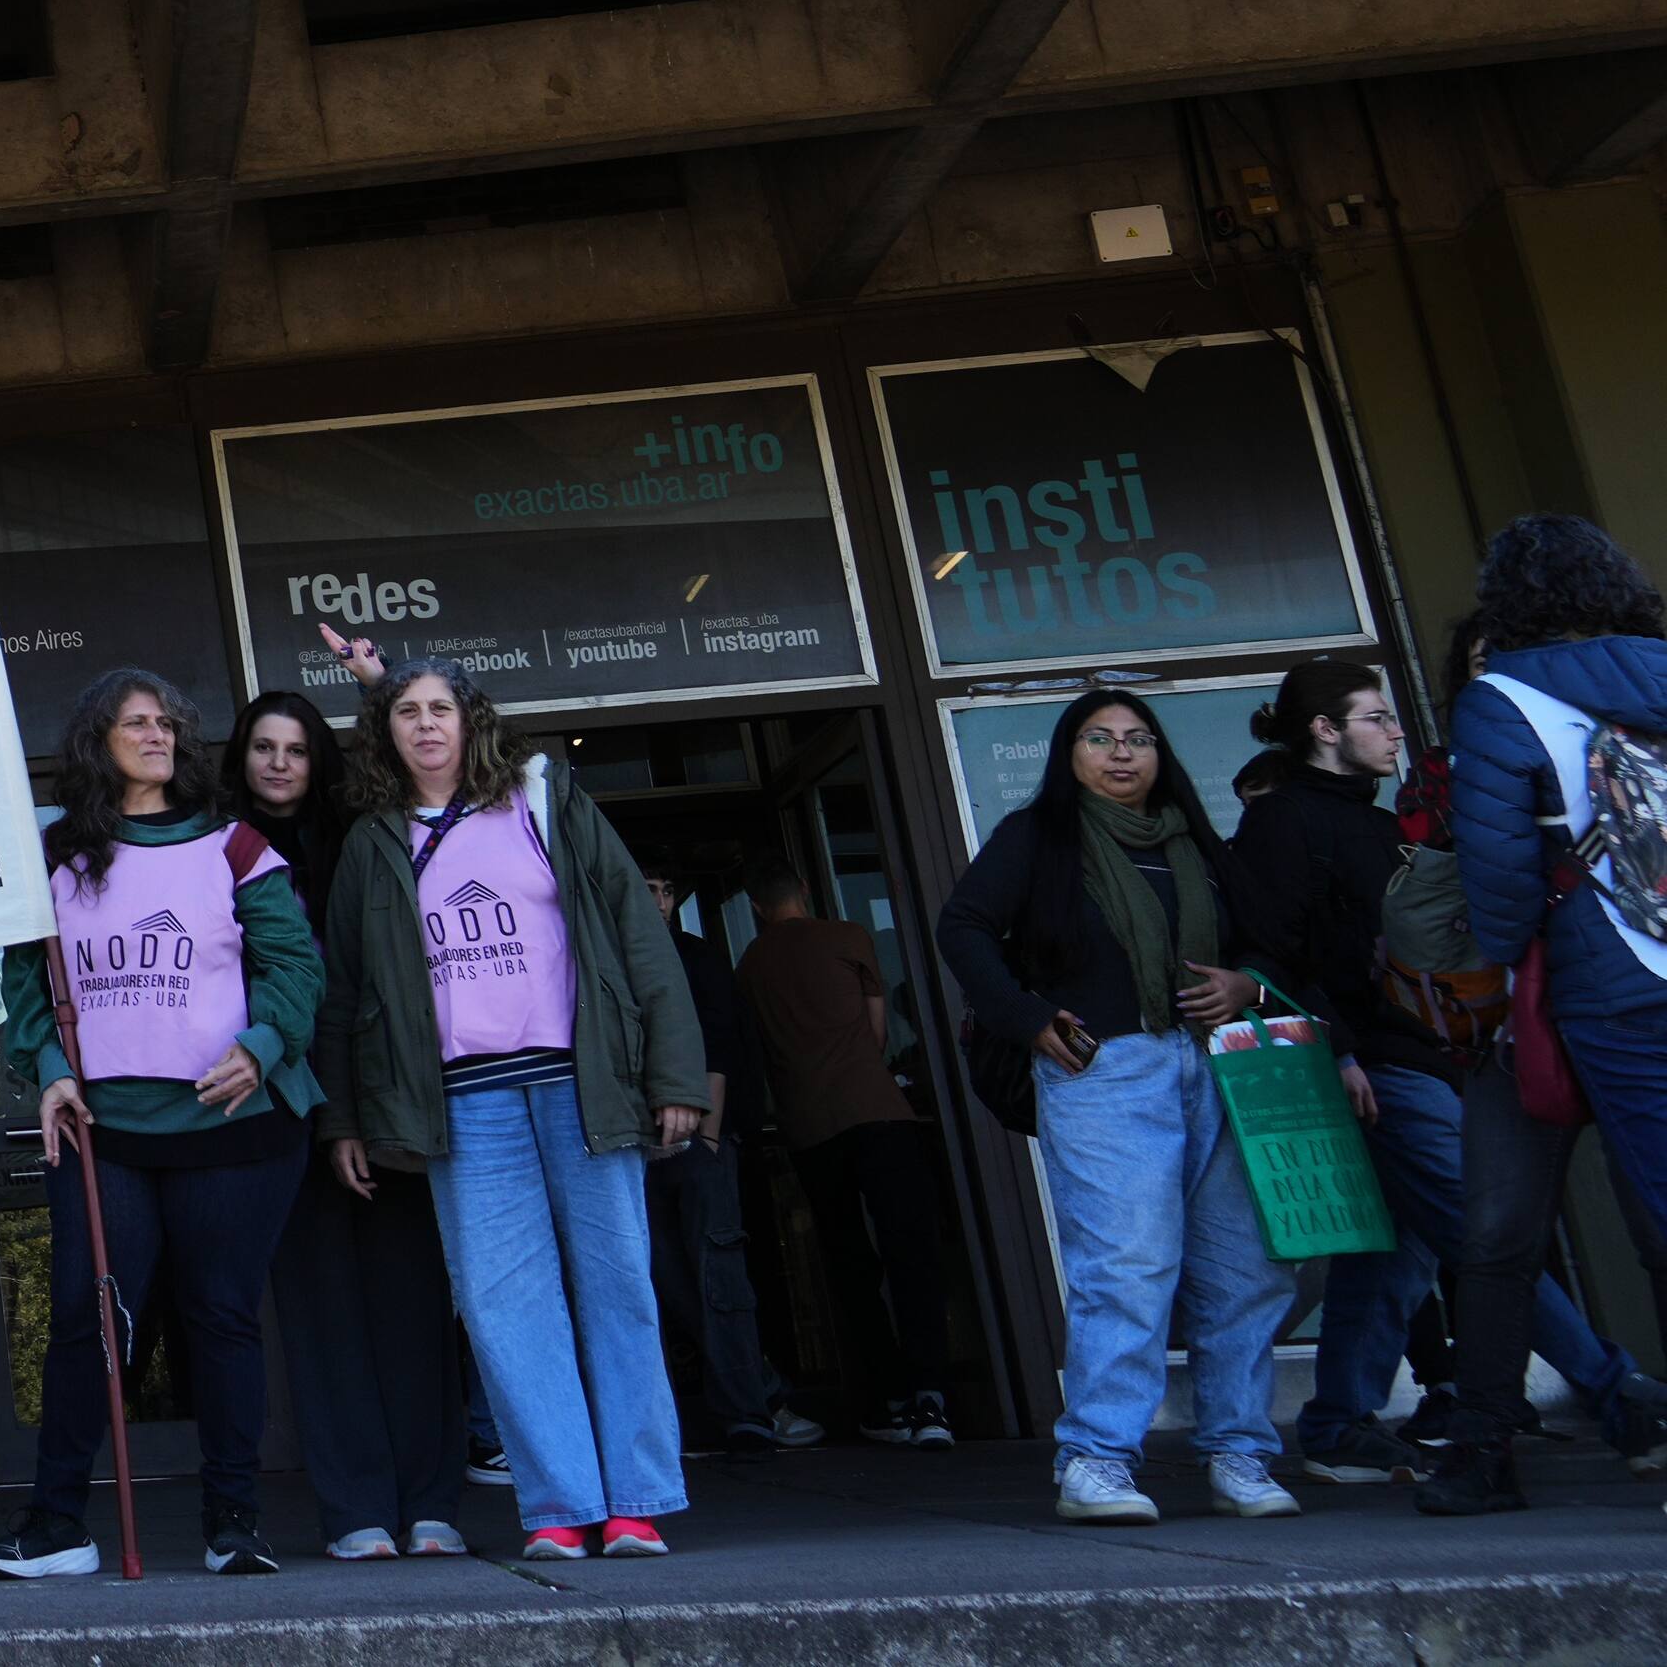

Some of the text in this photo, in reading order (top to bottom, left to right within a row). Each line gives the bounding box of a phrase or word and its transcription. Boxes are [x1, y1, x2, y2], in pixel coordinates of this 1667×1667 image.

[634, 415, 784, 475] +info
[474, 470, 730, 520] exactas.uba.ar
[287, 572, 440, 625] redes
[563, 620, 667, 643] /exactasubaoficial
[700, 612, 780, 630] /exactas_uba
[0, 628, 84, 655] nos Aires
[425, 636, 498, 654] /UBAExactas
[566, 638, 658, 668] youtube
[703, 627, 820, 656] instagram
[991, 739, 1051, 760] Pabell
[426, 901, 517, 945] ODO
[76, 933, 194, 975] NODO
[426, 941, 524, 970] BAJADORES EN RED
[78, 973, 190, 994] TRABAJADORES EN RED
[433, 964, 477, 988] ACTAS
[493, 958, 528, 977] UBA
[80, 991, 141, 1013] EXACTAS
[156, 990, 188, 1008] UBA
